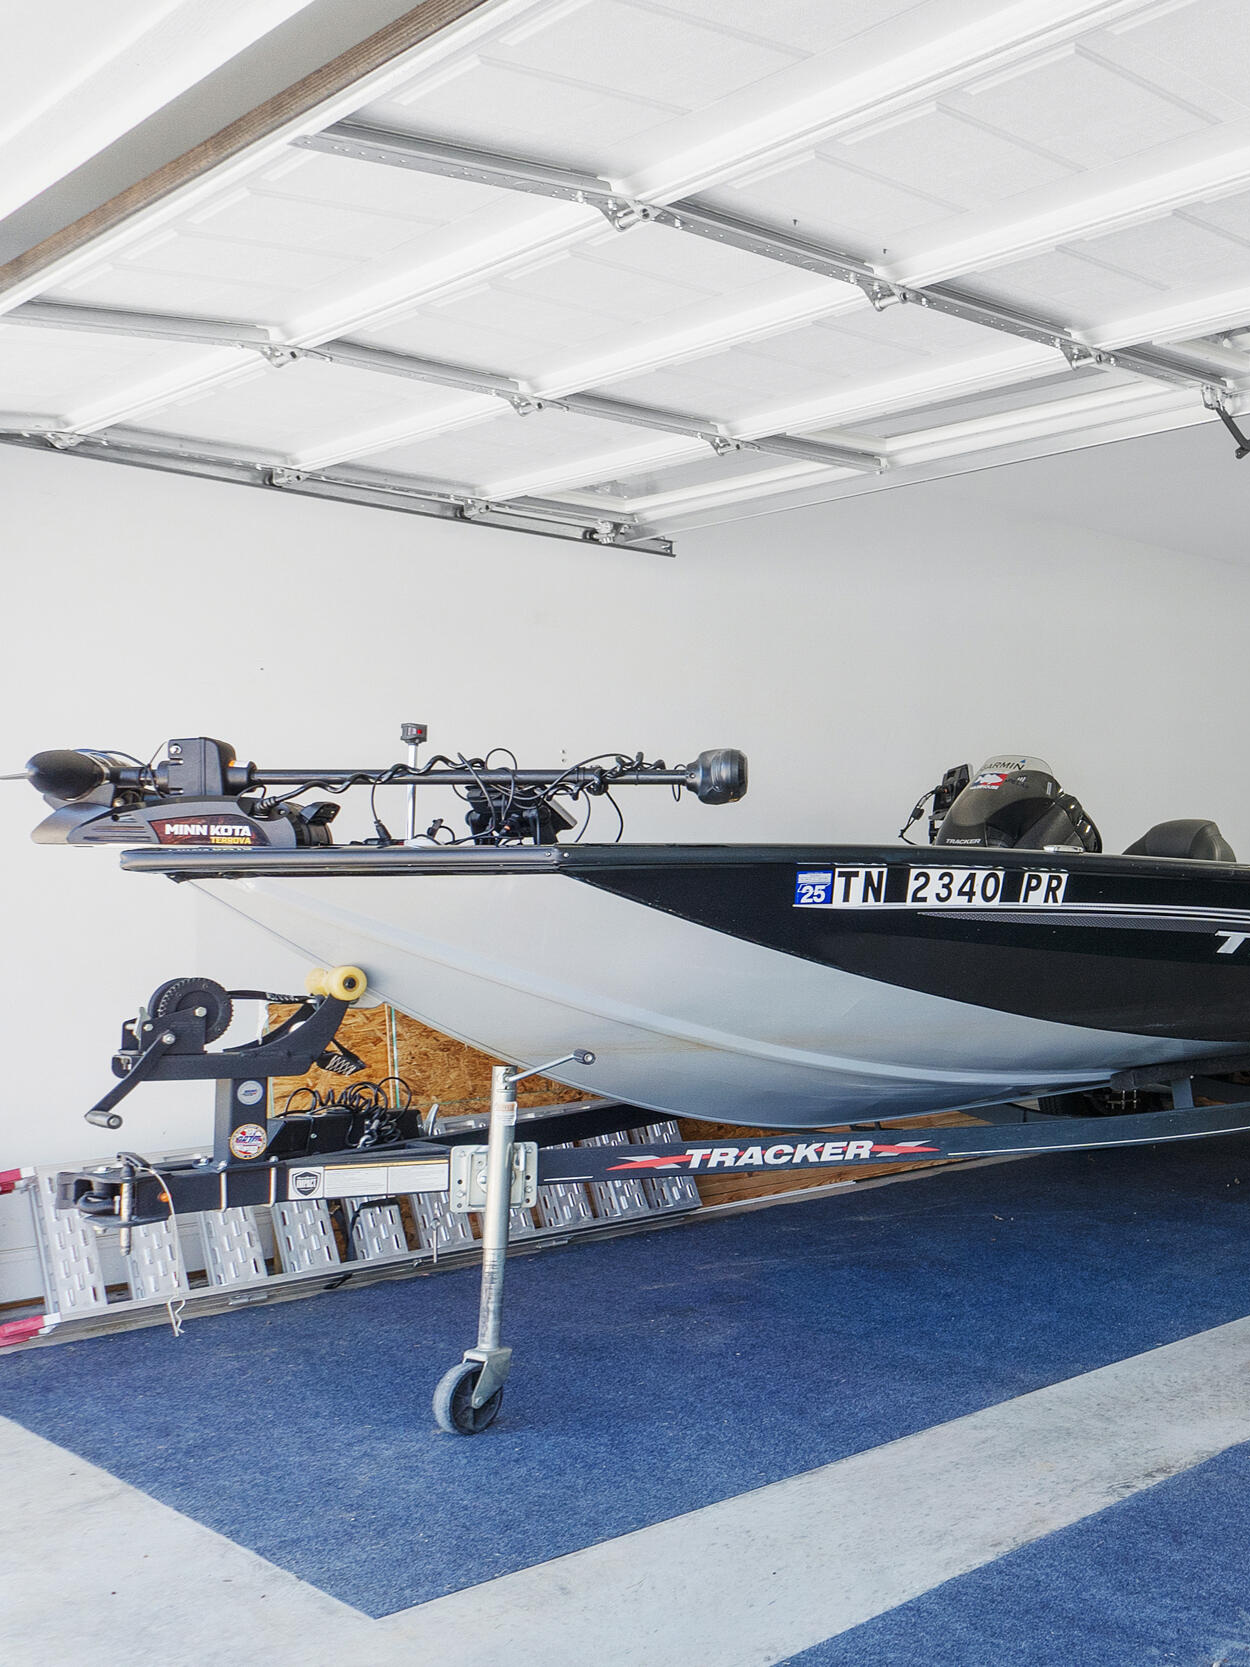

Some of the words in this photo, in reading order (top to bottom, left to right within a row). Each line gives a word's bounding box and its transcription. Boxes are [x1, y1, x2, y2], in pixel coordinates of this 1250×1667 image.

[164, 823, 208, 836] MINN
[209, 825, 252, 837] KOTA
[209, 836, 252, 845] TERROVA
[800, 884, 826, 903] 25
[836, 870, 884, 903] TN
[910, 871, 1001, 903] 2340
[1021, 872, 1064, 903] PR
[685, 1140, 874, 1169] TRACKER
